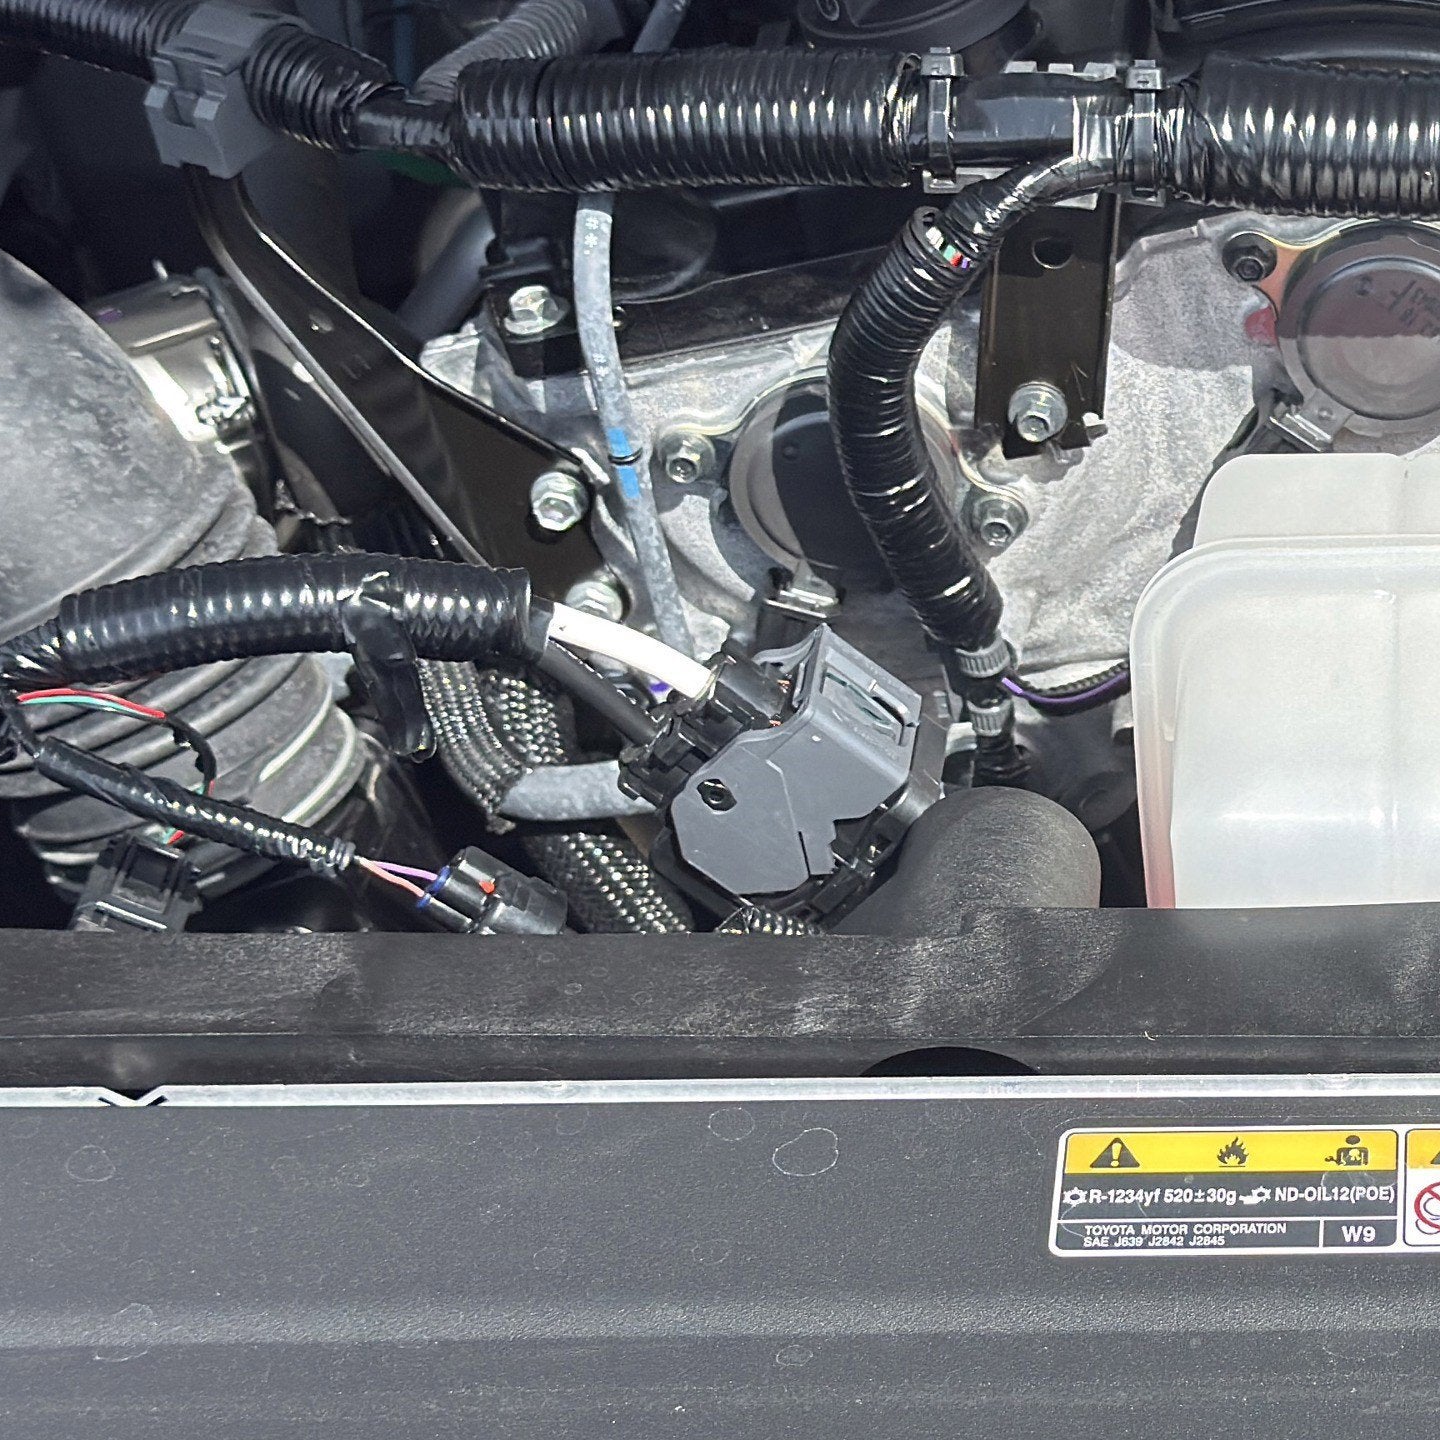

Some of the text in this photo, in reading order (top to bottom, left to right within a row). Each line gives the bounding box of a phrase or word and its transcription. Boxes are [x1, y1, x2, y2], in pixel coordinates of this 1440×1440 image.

[1089, 1185, 1395, 1206] R-1234yf 520±30g ND-OIL12(POE)
[1084, 1223, 1287, 1236] TOYOTA MOTOR CORPORATION
[1341, 1225, 1376, 1243] W9
[1083, 1236, 1111, 1248] SAE
[1148, 1236, 1184, 1247] J2842
